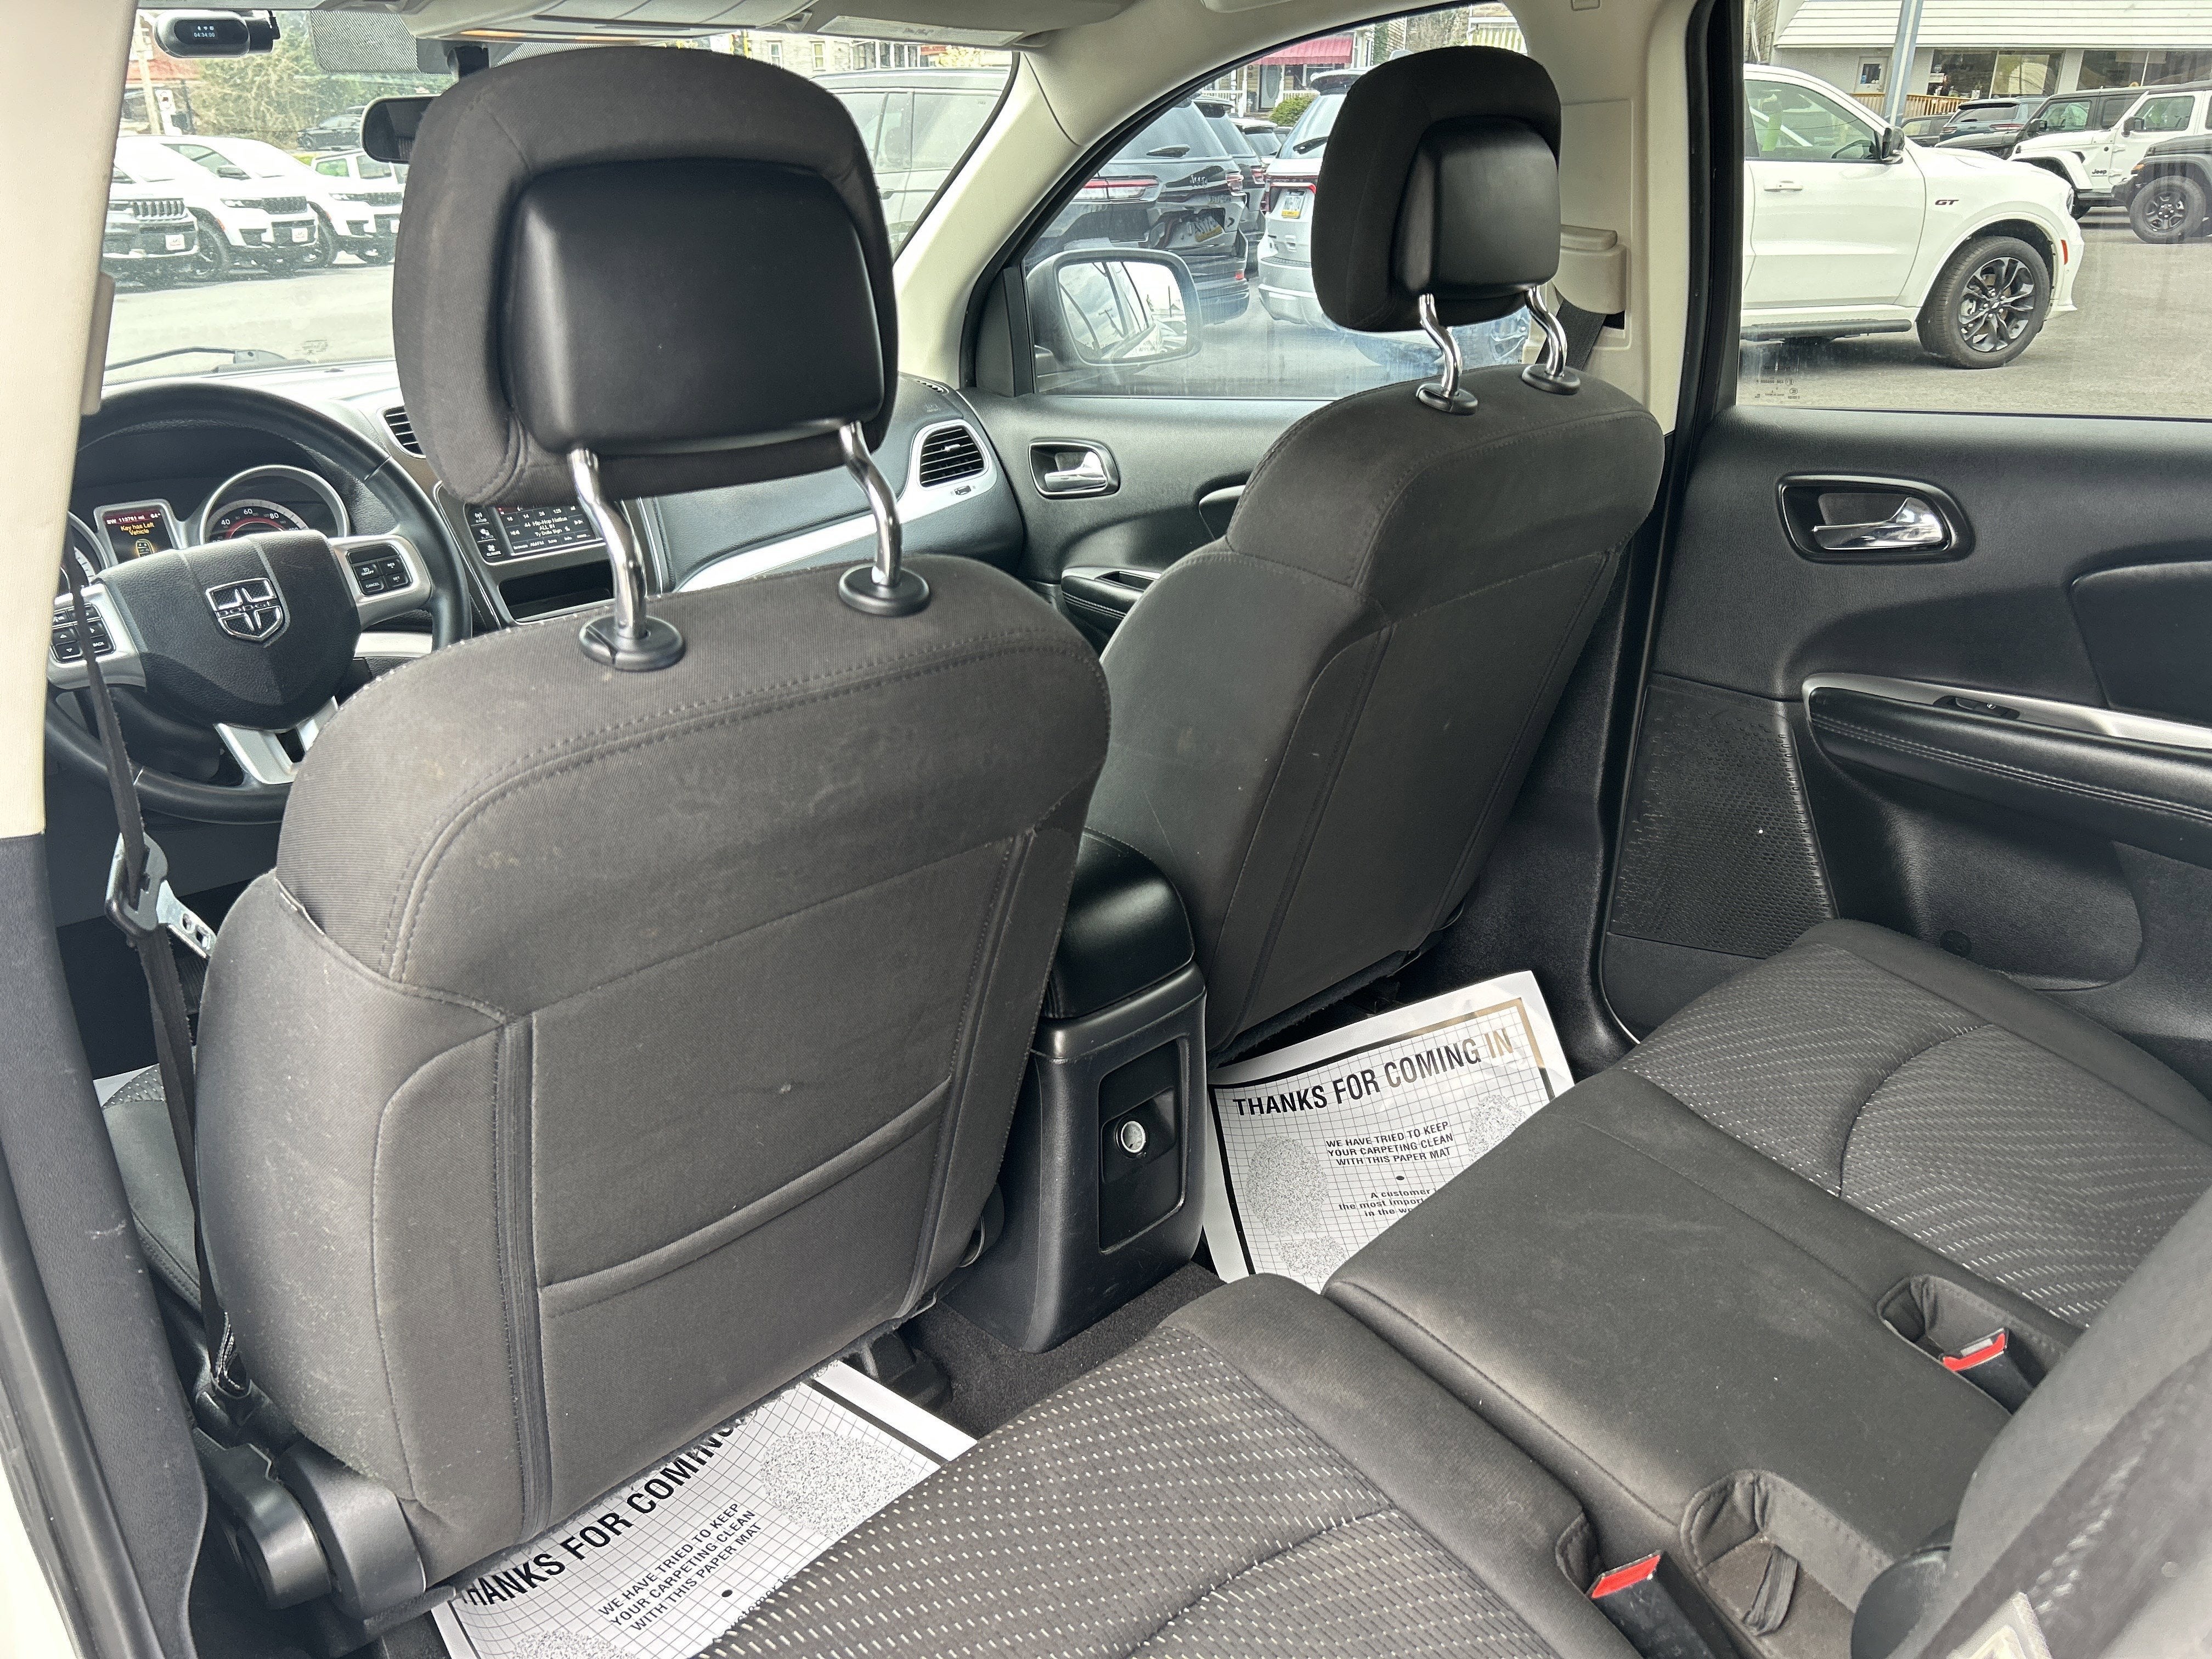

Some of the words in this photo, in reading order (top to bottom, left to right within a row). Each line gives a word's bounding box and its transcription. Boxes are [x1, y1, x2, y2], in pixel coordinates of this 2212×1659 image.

[1233, 1085, 1327, 1116] THANKS
[1333, 1069, 1380, 1104] FOR
[1384, 1038, 1482, 1088] COMING
[1484, 1028, 1514, 1059] IN
[1336, 1157, 1364, 1166] WITH
[1366, 1155, 1390, 1164] THIS
[1393, 1152, 1427, 1163] PAPER
[1429, 1147, 1452, 1159] MAT
[1345, 1137, 1372, 1146] HAVE
[1374, 1132, 1405, 1144] TRIED
[1407, 1128, 1421, 1139] TO
[1423, 1121, 1449, 1135] KEEP
[1360, 1142, 1418, 1155] CARPETING
[1420, 1133, 1454, 1149] CLEAN
[1359, 1200, 1387, 1209] most
[1381, 1189, 1431, 1198] customer
[462, 1553, 566, 1606] HANKS
[560, 1513, 634, 1560] FOR
[598, 1598, 624, 1616] WE
[622, 1572, 658, 1600] HAVE
[655, 1544, 694, 1573] TRIED
[692, 1529, 712, 1543] TO
[709, 1503, 739, 1529] KEEP
[610, 1598, 651, 1626] YOUR
[650, 1543, 718, 1598] CARPETING
[716, 1510, 756, 1542] CLEAN
[630, 1603, 668, 1631] WITH
[665, 1578, 697, 1603] THIS
[696, 1545, 737, 1578] PAPER
[734, 1522, 761, 1546] MAT
